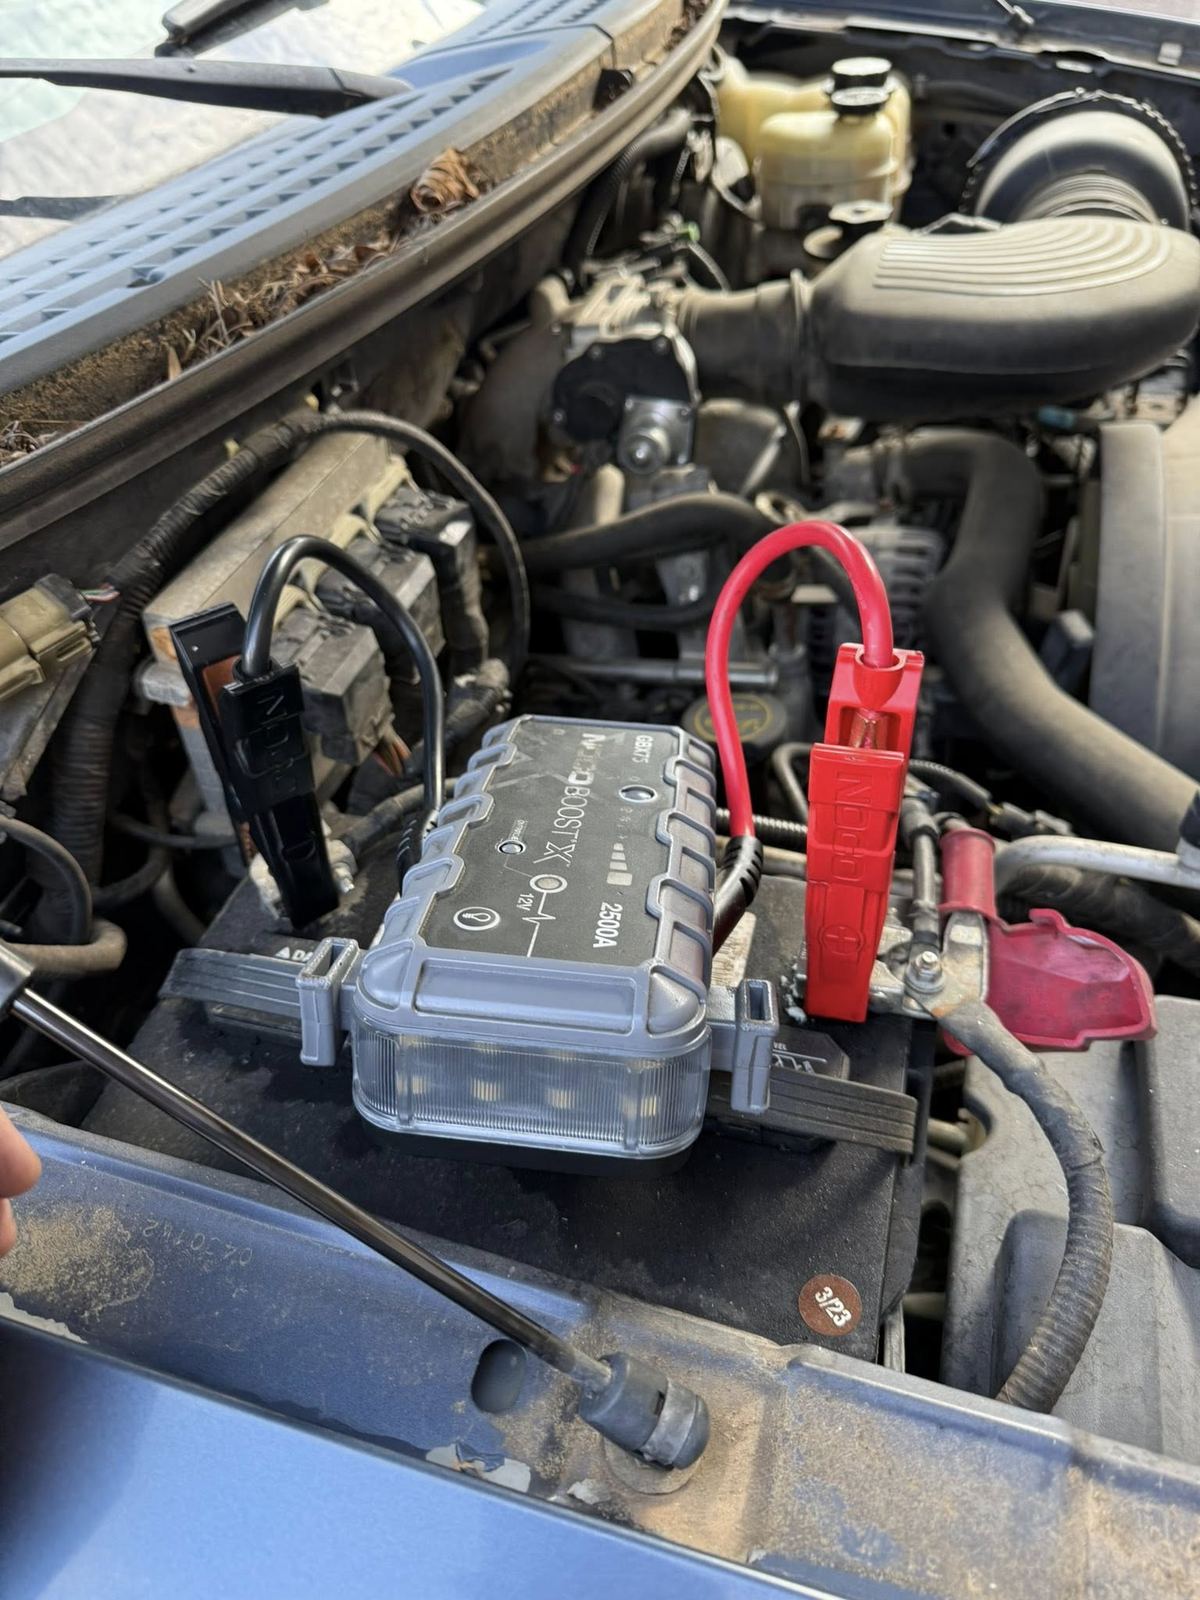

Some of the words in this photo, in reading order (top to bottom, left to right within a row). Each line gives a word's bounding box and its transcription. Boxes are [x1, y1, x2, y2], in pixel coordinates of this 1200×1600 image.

[633, 734, 654, 763] GBX75
[551, 786, 591, 841] BOOST
[831, 770, 872, 882] NOCO
[516, 893, 535, 912] 12V
[592, 902, 622, 948] 2500A
[815, 1286, 852, 1328] 3/23
